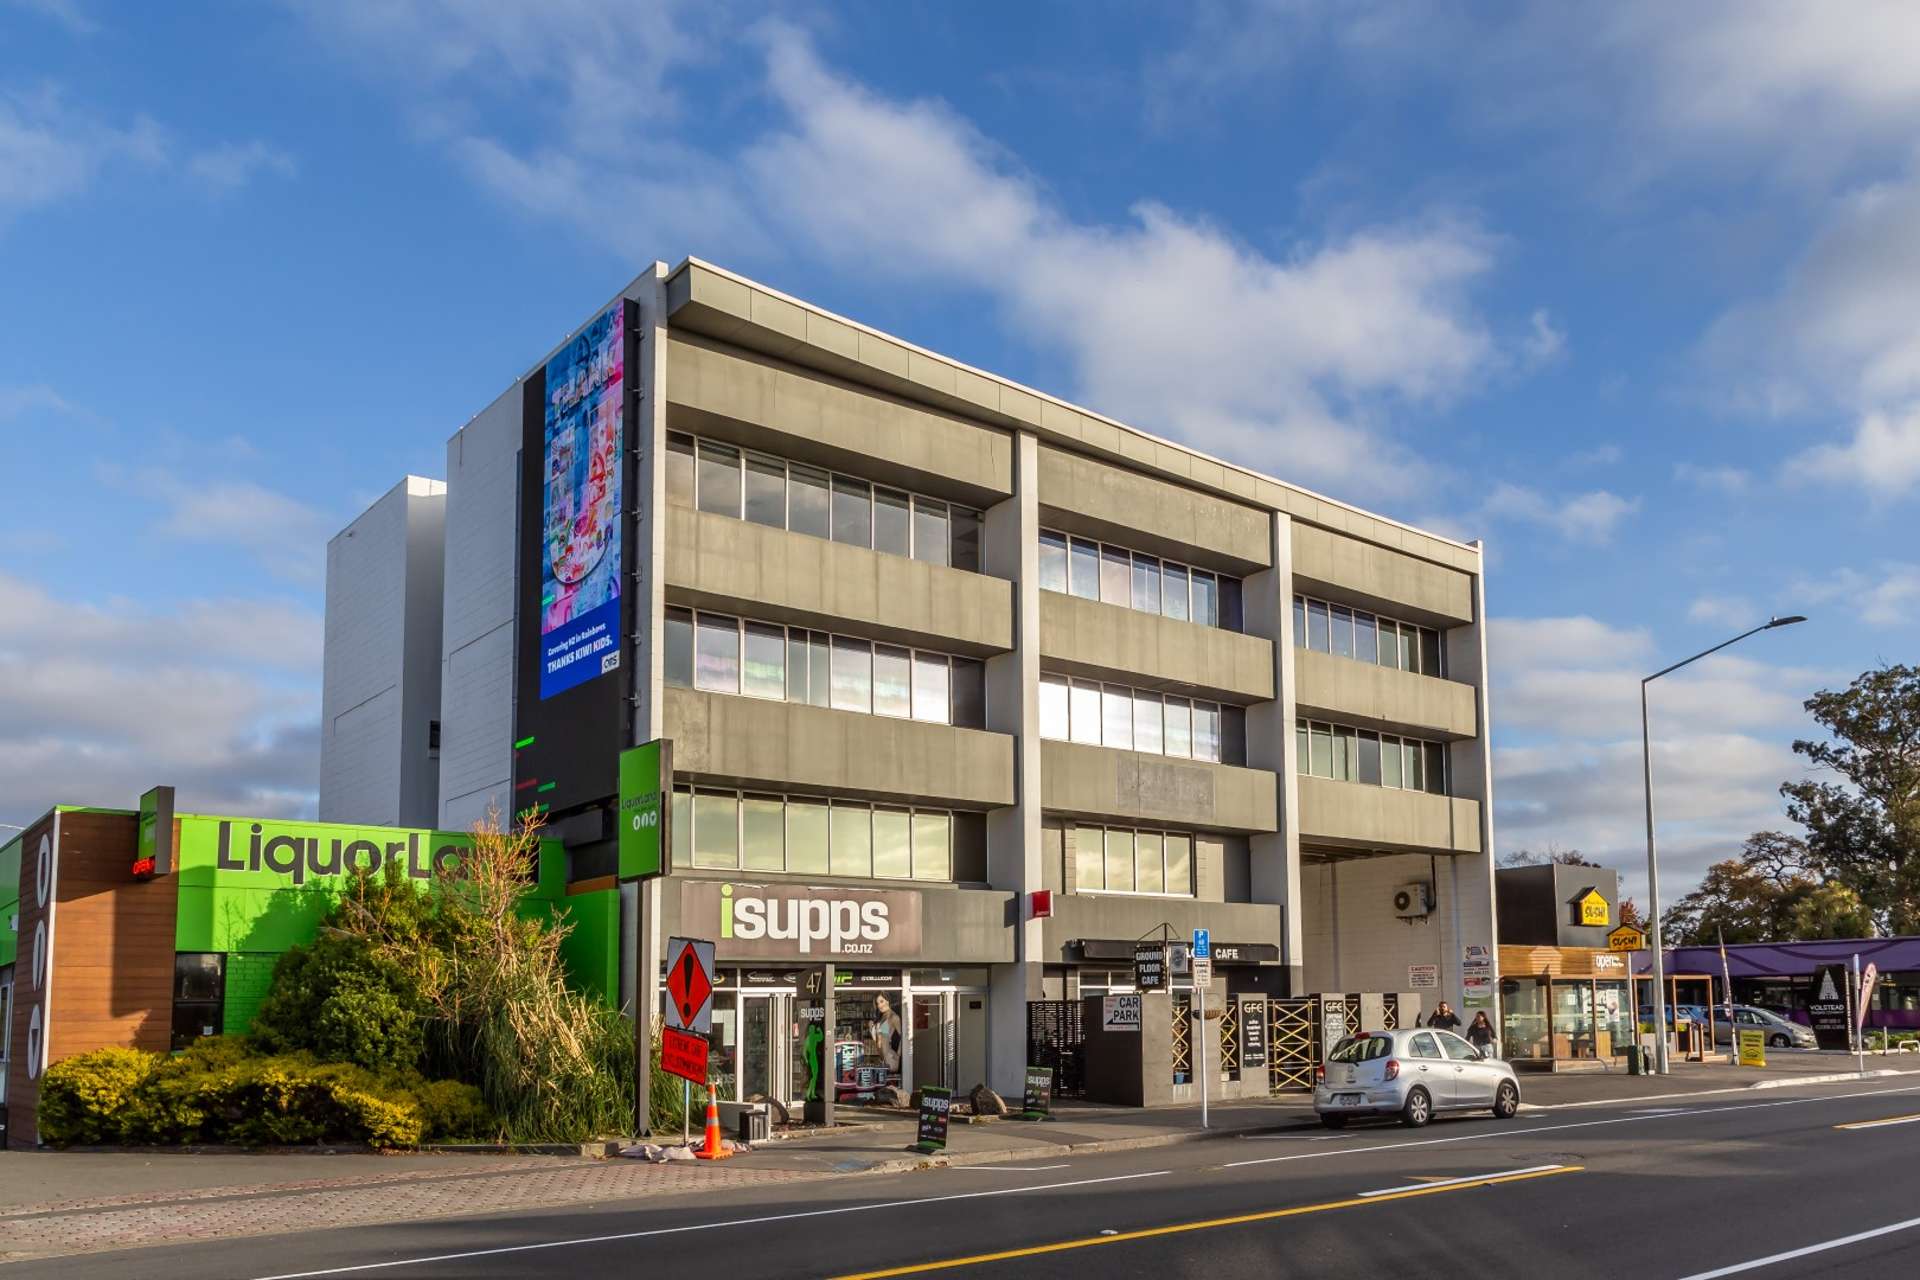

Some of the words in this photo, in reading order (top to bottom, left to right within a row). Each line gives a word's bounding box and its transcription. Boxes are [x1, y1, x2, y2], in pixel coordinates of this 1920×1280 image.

[581, 622, 607, 641] Rainbows
[547, 651, 575, 674] THANKS
[575, 643, 593, 661] KIWI
[721, 883, 890, 953] isupps
[1612, 936, 1638, 947] SUSHI
[1135, 951, 1163, 961] GROUND
[1215, 948, 1239, 959] CAFE
[1139, 963, 1160, 973] FLOOR
[805, 972, 822, 995] 47
[1141, 975, 1159, 985] CAFE
[1119, 997, 1139, 1009] CAR
[1113, 1009, 1139, 1021] PARK
